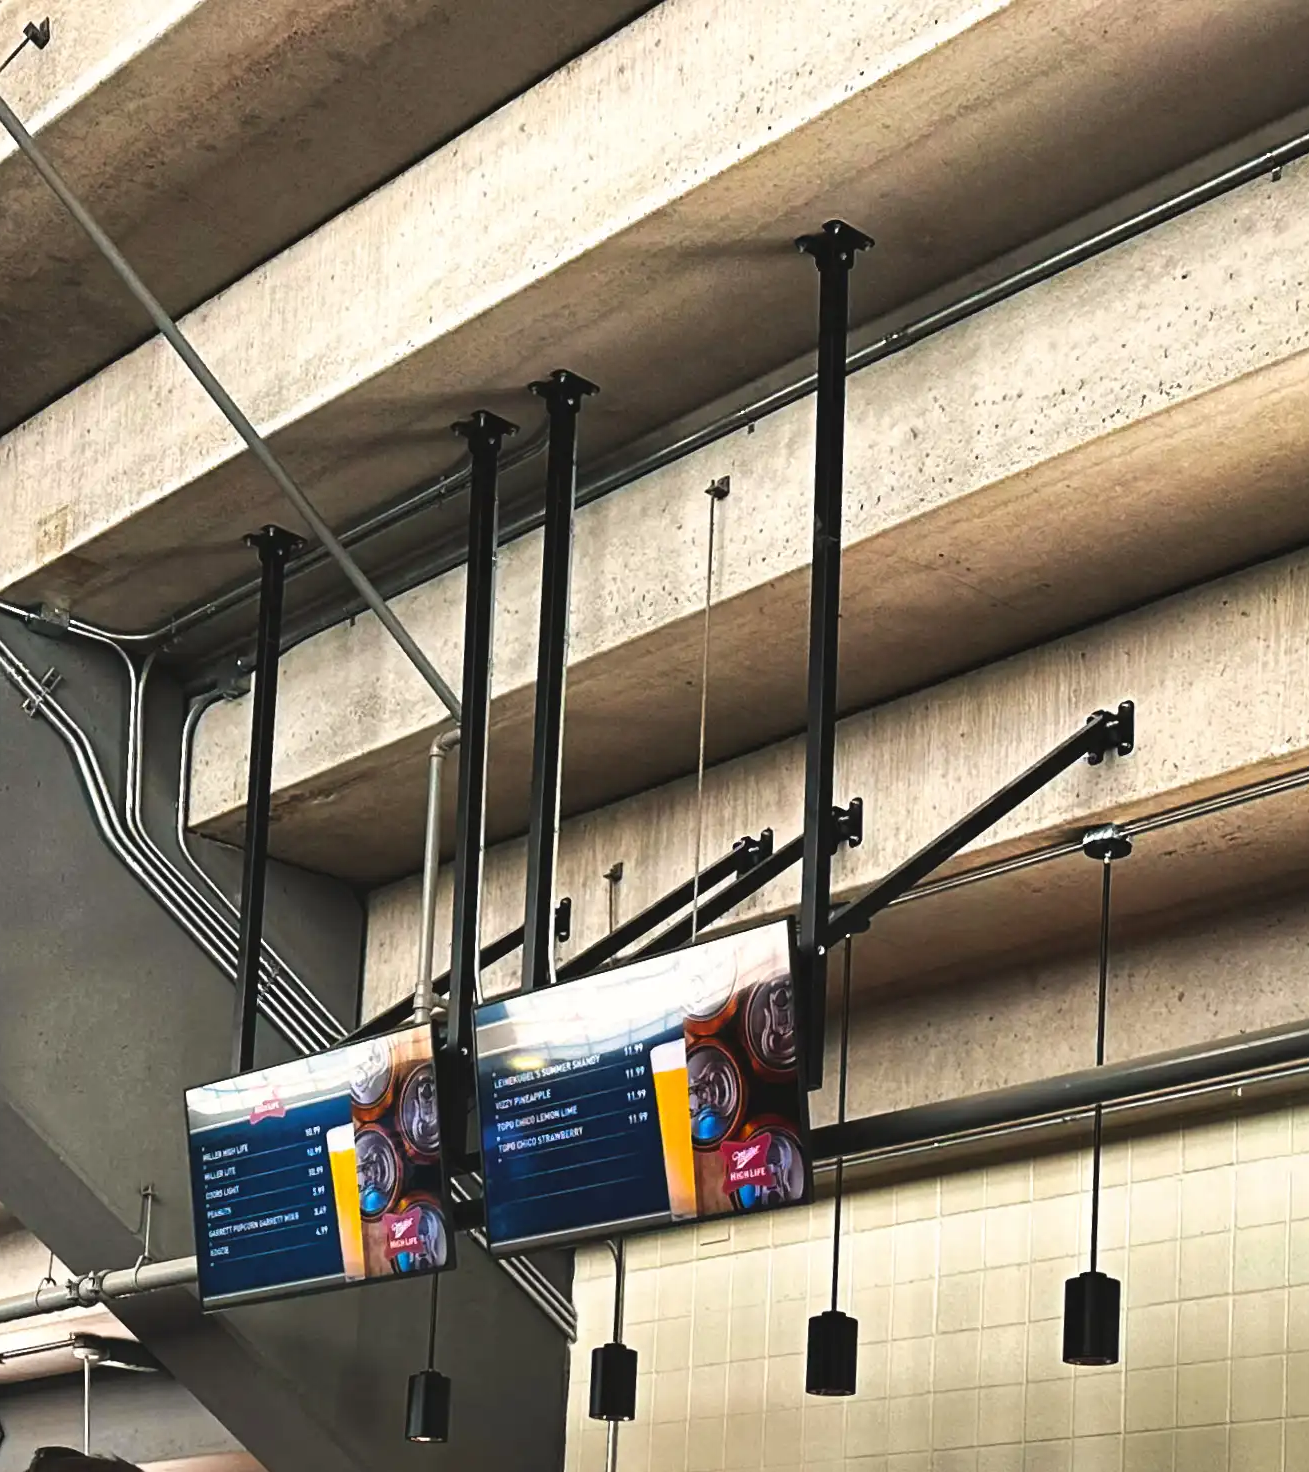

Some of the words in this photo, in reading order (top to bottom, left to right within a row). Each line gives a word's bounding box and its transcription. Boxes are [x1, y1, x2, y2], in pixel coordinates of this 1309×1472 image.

[623, 1043, 644, 1056] 11.99
[541, 1061, 571, 1077] SUMMER
[572, 1053, 601, 1069] SHANDY
[625, 1066, 645, 1079] 11.99
[513, 1088, 551, 1107] PINEAPPLE
[627, 1089, 646, 1102] 11.99
[497, 1120, 514, 1132] TOPO
[515, 1115, 535, 1128] CHICO
[536, 1109, 559, 1123] LEMON
[560, 1105, 578, 1117] LIME
[628, 1112, 648, 1125] 11.99
[498, 1142, 516, 1153] TOPO
[516, 1137, 536, 1149] CHICO
[537, 1126, 583, 1145] STRAWBERRY
[203, 1151, 222, 1161] MILLER
[237, 1143, 249, 1154] LIFE
[204, 1170, 224, 1181] MILLER
[730, 1170, 749, 1181] HIGH
[750, 1167, 766, 1178] LIFE
[223, 1185, 239, 1198] LIGHT
[405, 1236, 418, 1245] LIFE
